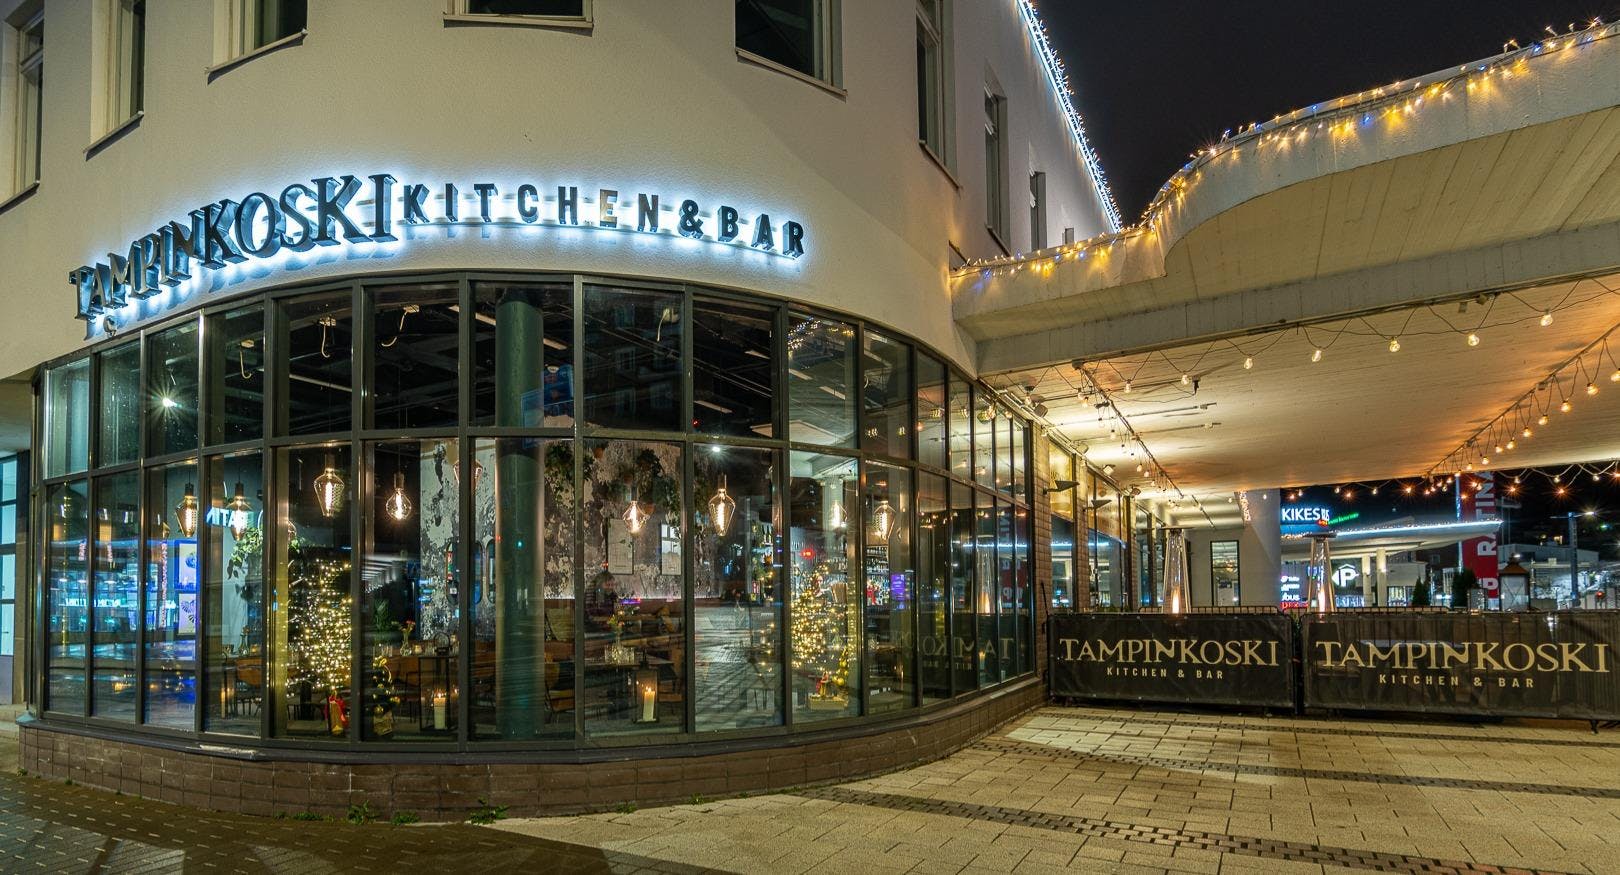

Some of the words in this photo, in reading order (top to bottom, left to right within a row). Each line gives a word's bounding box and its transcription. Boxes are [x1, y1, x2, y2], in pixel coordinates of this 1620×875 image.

[68, 173, 399, 321] TAMPINKOSKI
[1059, 638, 1279, 667] TAMPINKOSKI
[1315, 641, 1610, 673] TAMPINKOSKI
[1106, 667, 1167, 678] KITCHEN
[1177, 669, 1185, 678] &
[1196, 670, 1224, 680] BAR
[1379, 673, 1459, 687] KITCHEN
[1473, 676, 1482, 687] &
[1498, 677, 1534, 688] BAR
